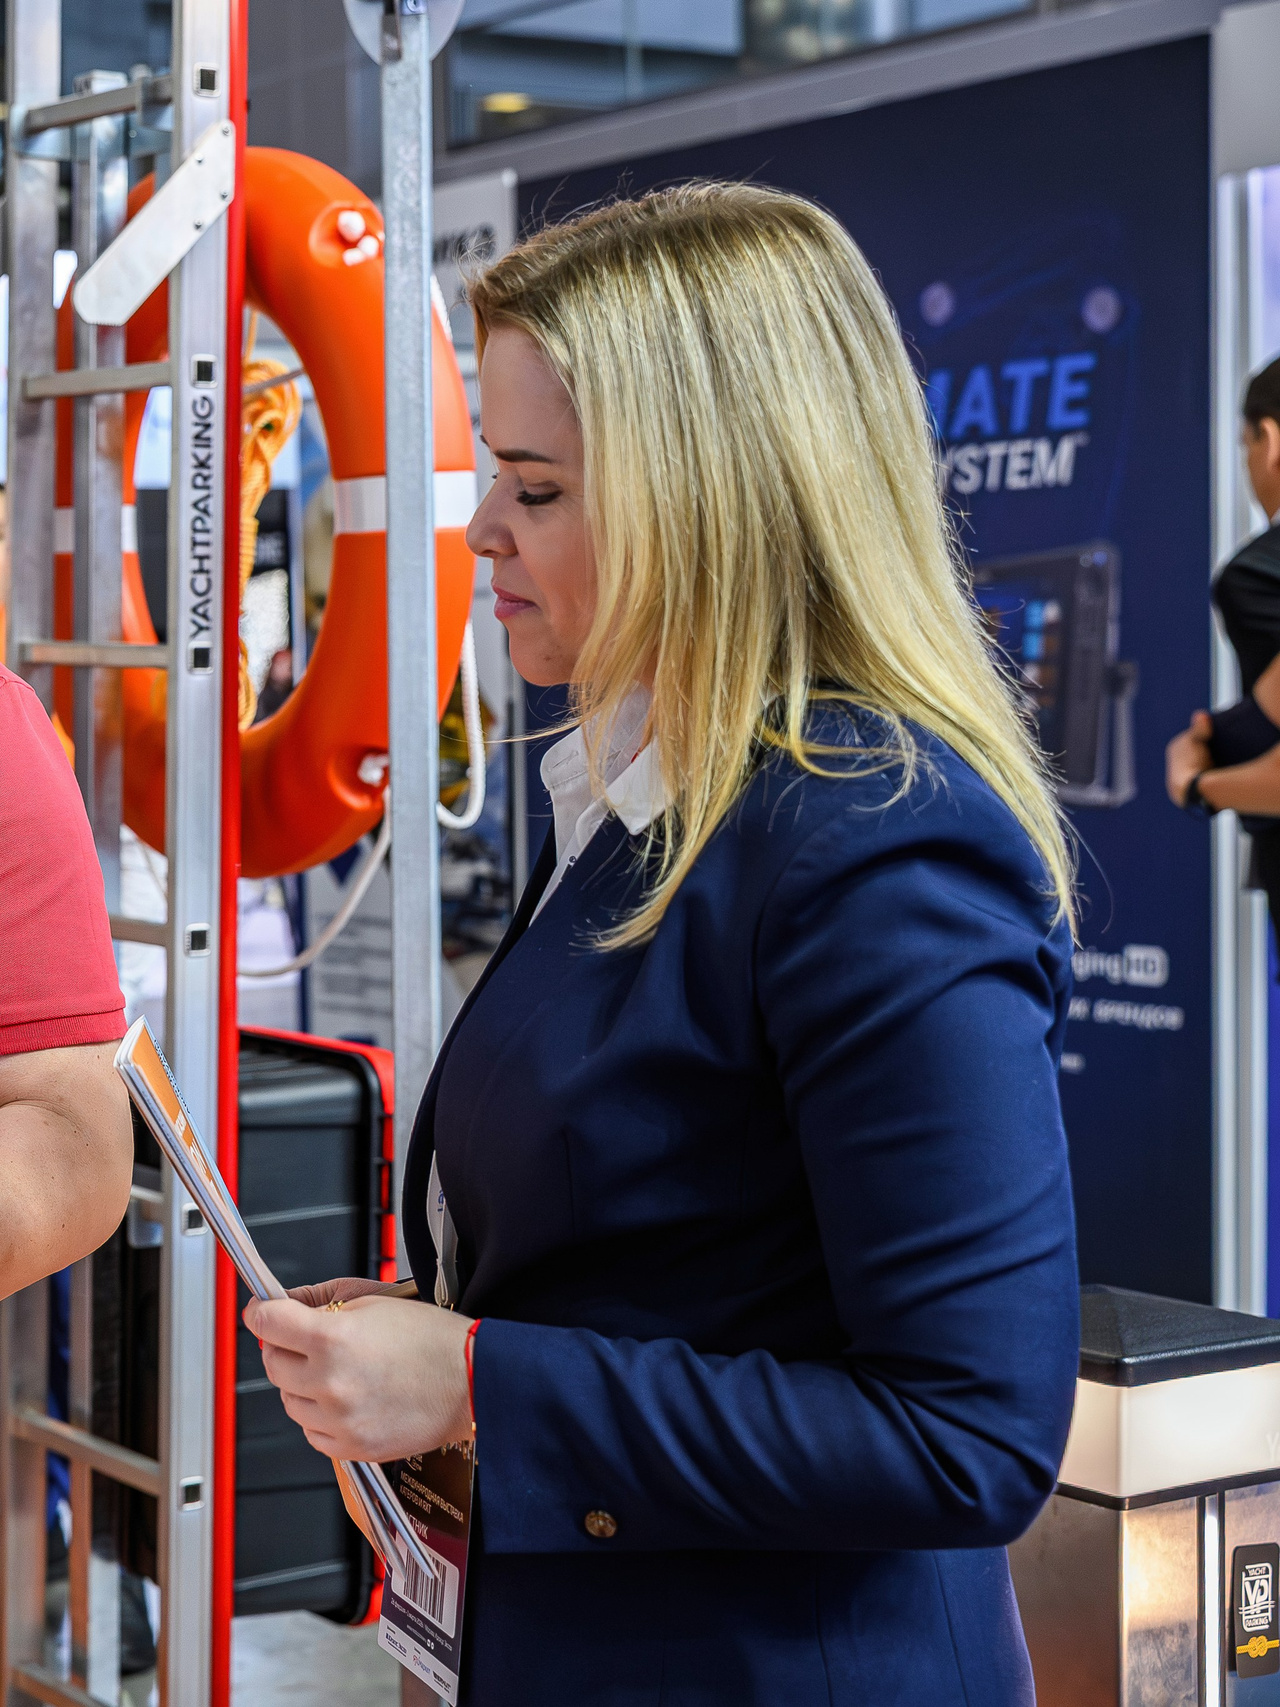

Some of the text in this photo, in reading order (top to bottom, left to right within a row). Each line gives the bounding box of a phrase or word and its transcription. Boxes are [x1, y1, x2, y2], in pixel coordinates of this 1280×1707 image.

[190, 395, 214, 639] YACHTPARKING
[1247, 1566, 1267, 1577] YACHT
[1245, 1616, 1269, 1627] PARKING
